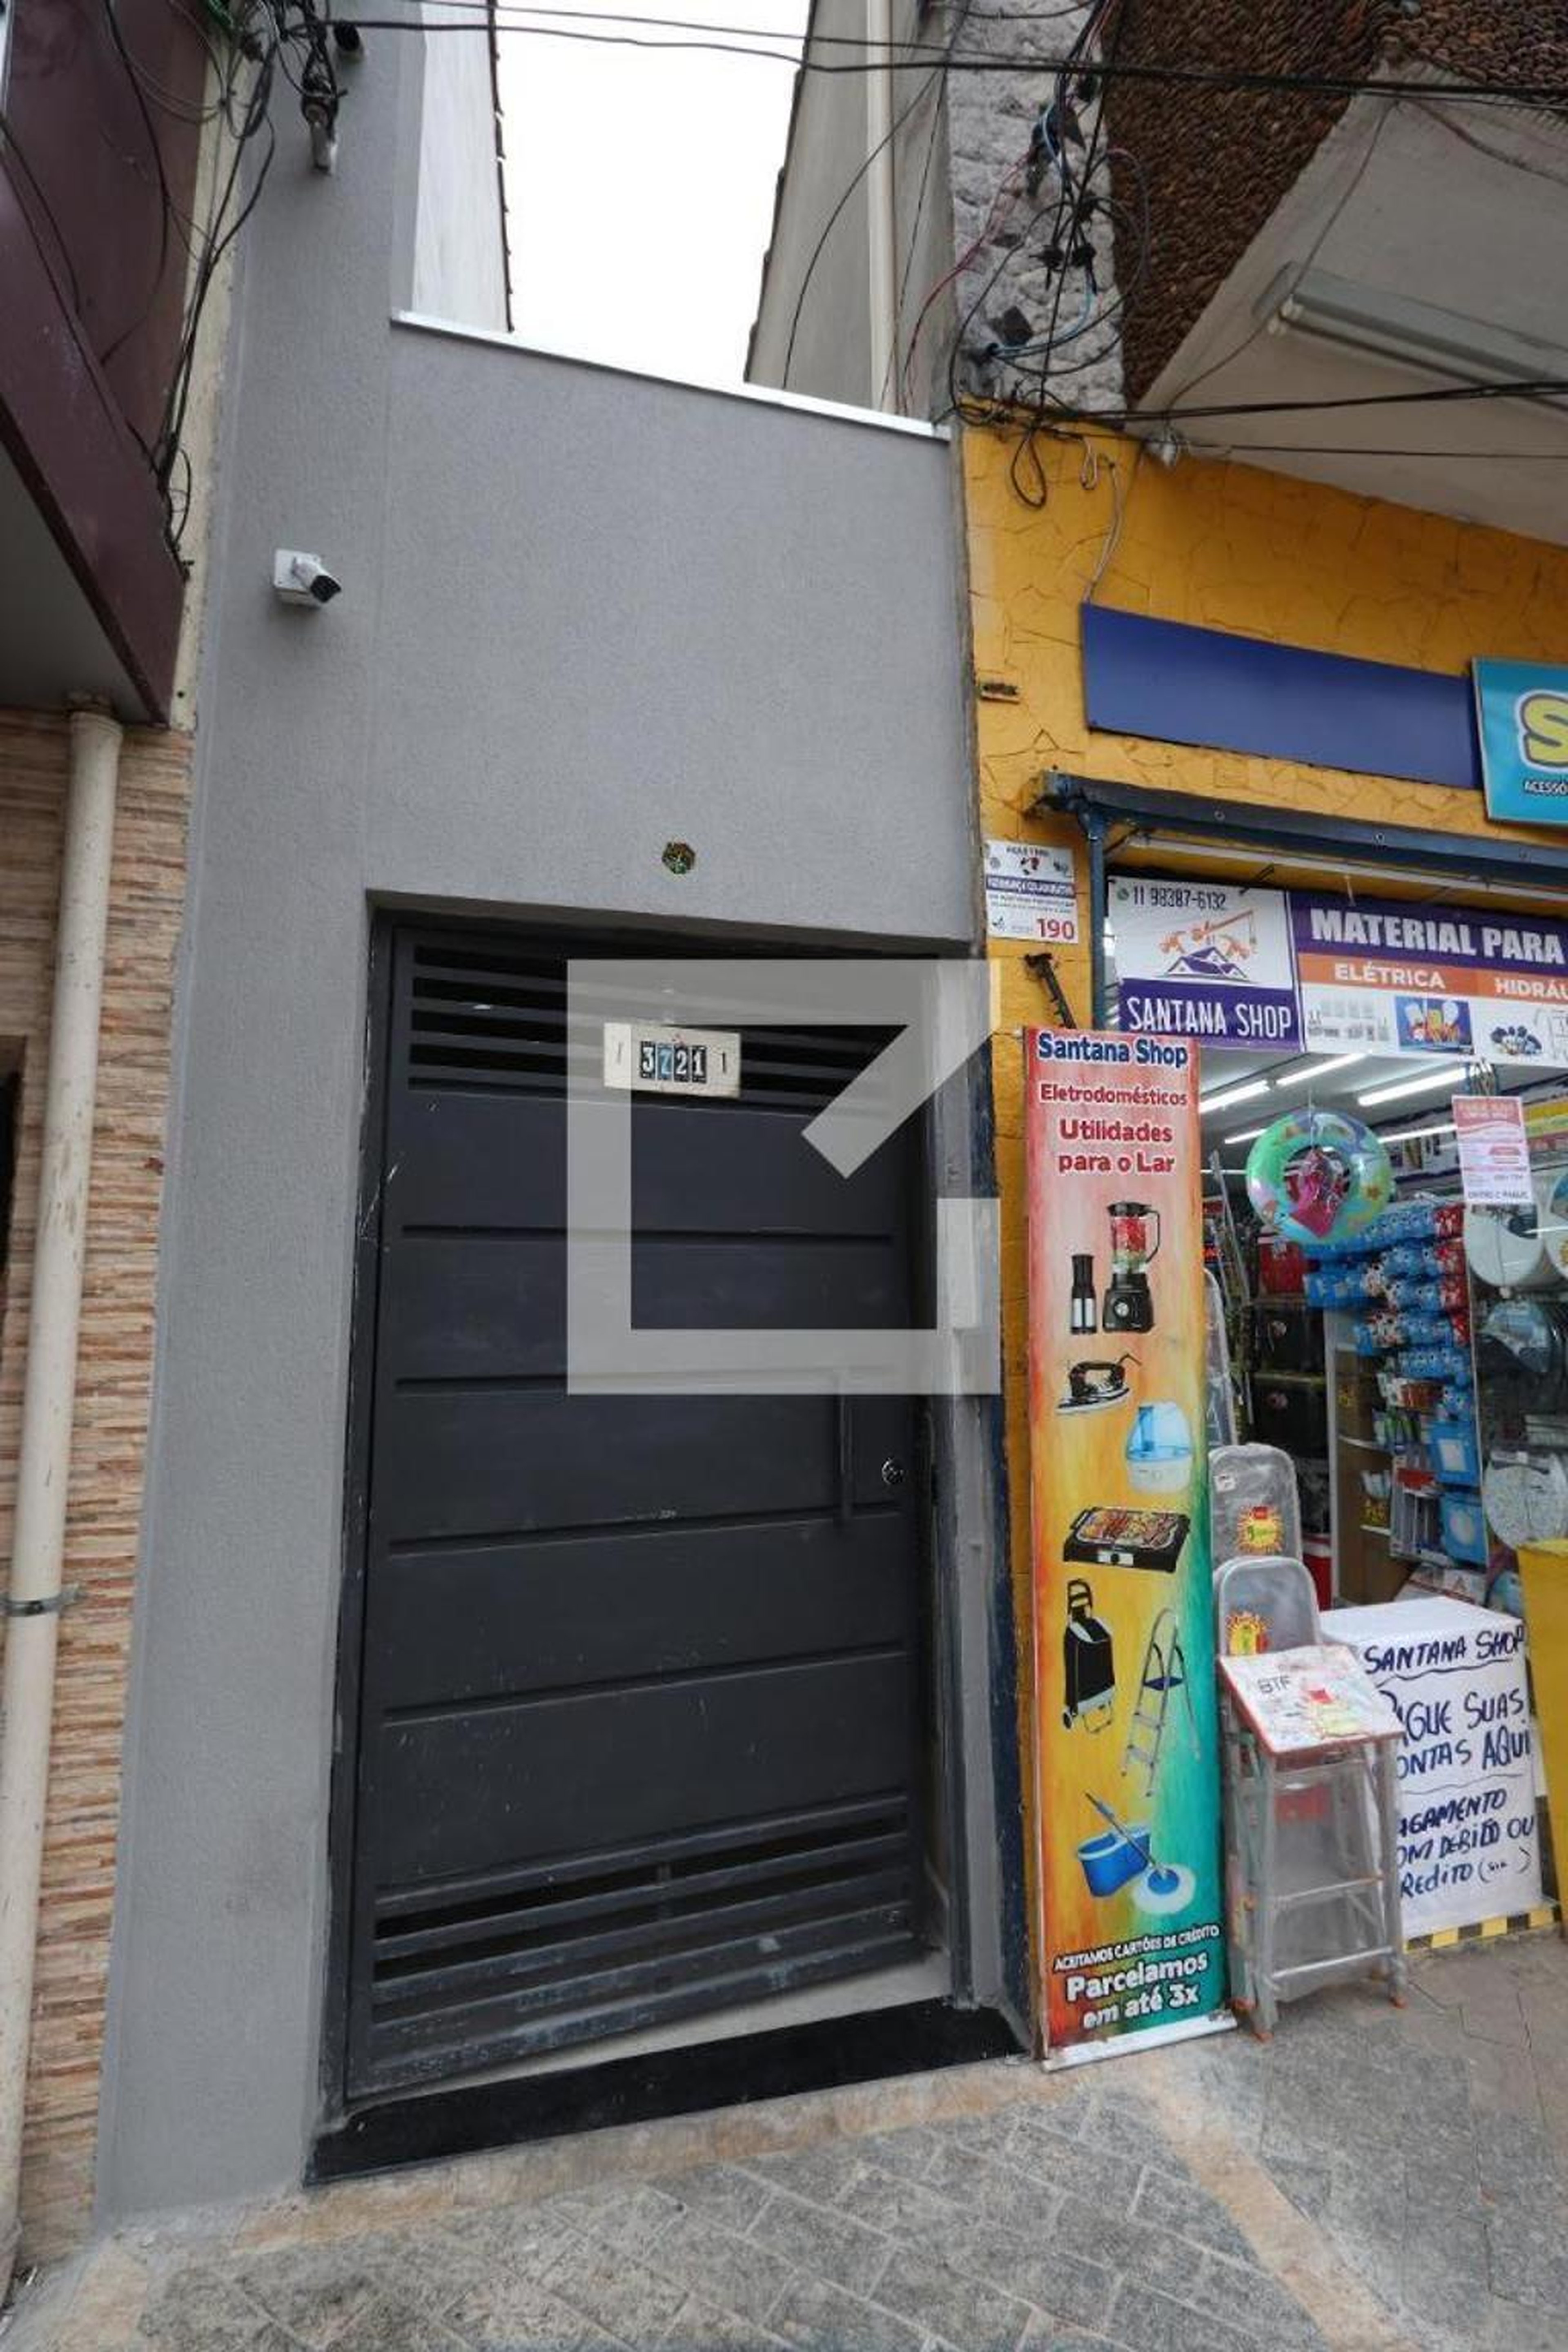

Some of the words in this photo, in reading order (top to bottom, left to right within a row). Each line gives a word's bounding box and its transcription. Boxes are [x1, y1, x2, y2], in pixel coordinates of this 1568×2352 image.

[1037, 919, 1074, 940] 190
[1310, 908, 1477, 956] MATERIAL
[1481, 927, 1565, 964] PARA
[1335, 961, 1446, 989] ELÉTRICA
[1127, 997, 1227, 1034] SANTANA
[1235, 1003, 1292, 1038] SHOP
[1038, 1033, 1129, 1062] Santana
[1136, 1040, 1188, 1067] Shop
[1041, 1083, 1187, 1105] Eletrodomésticos
[1061, 1120, 1173, 1142] Utilidades
[1059, 1155, 1110, 1173] para
[1118, 1157, 1131, 1172] o
[1138, 1154, 1175, 1172] Lar
[1364, 1636, 1467, 1674] SANTANA
[1476, 1625, 1525, 1660] SHOP
[1464, 1688, 1524, 1729] SUAS
[1399, 1788, 1507, 1837] AGAMENTO
[1507, 1816, 1534, 1839] OU
[1054, 1948, 1114, 1971] ACEITAMOS
[1114, 1937, 1162, 1958] CARTÕES
[1164, 1936, 1176, 1948] DE
[1178, 1924, 1220, 1945] CRÉDITO
[1067, 1953, 1208, 2001] Parcelamos
[1084, 2004, 1118, 2028] em
[1125, 1987, 1163, 2017] até
[1169, 1984, 1199, 2007] 3x
